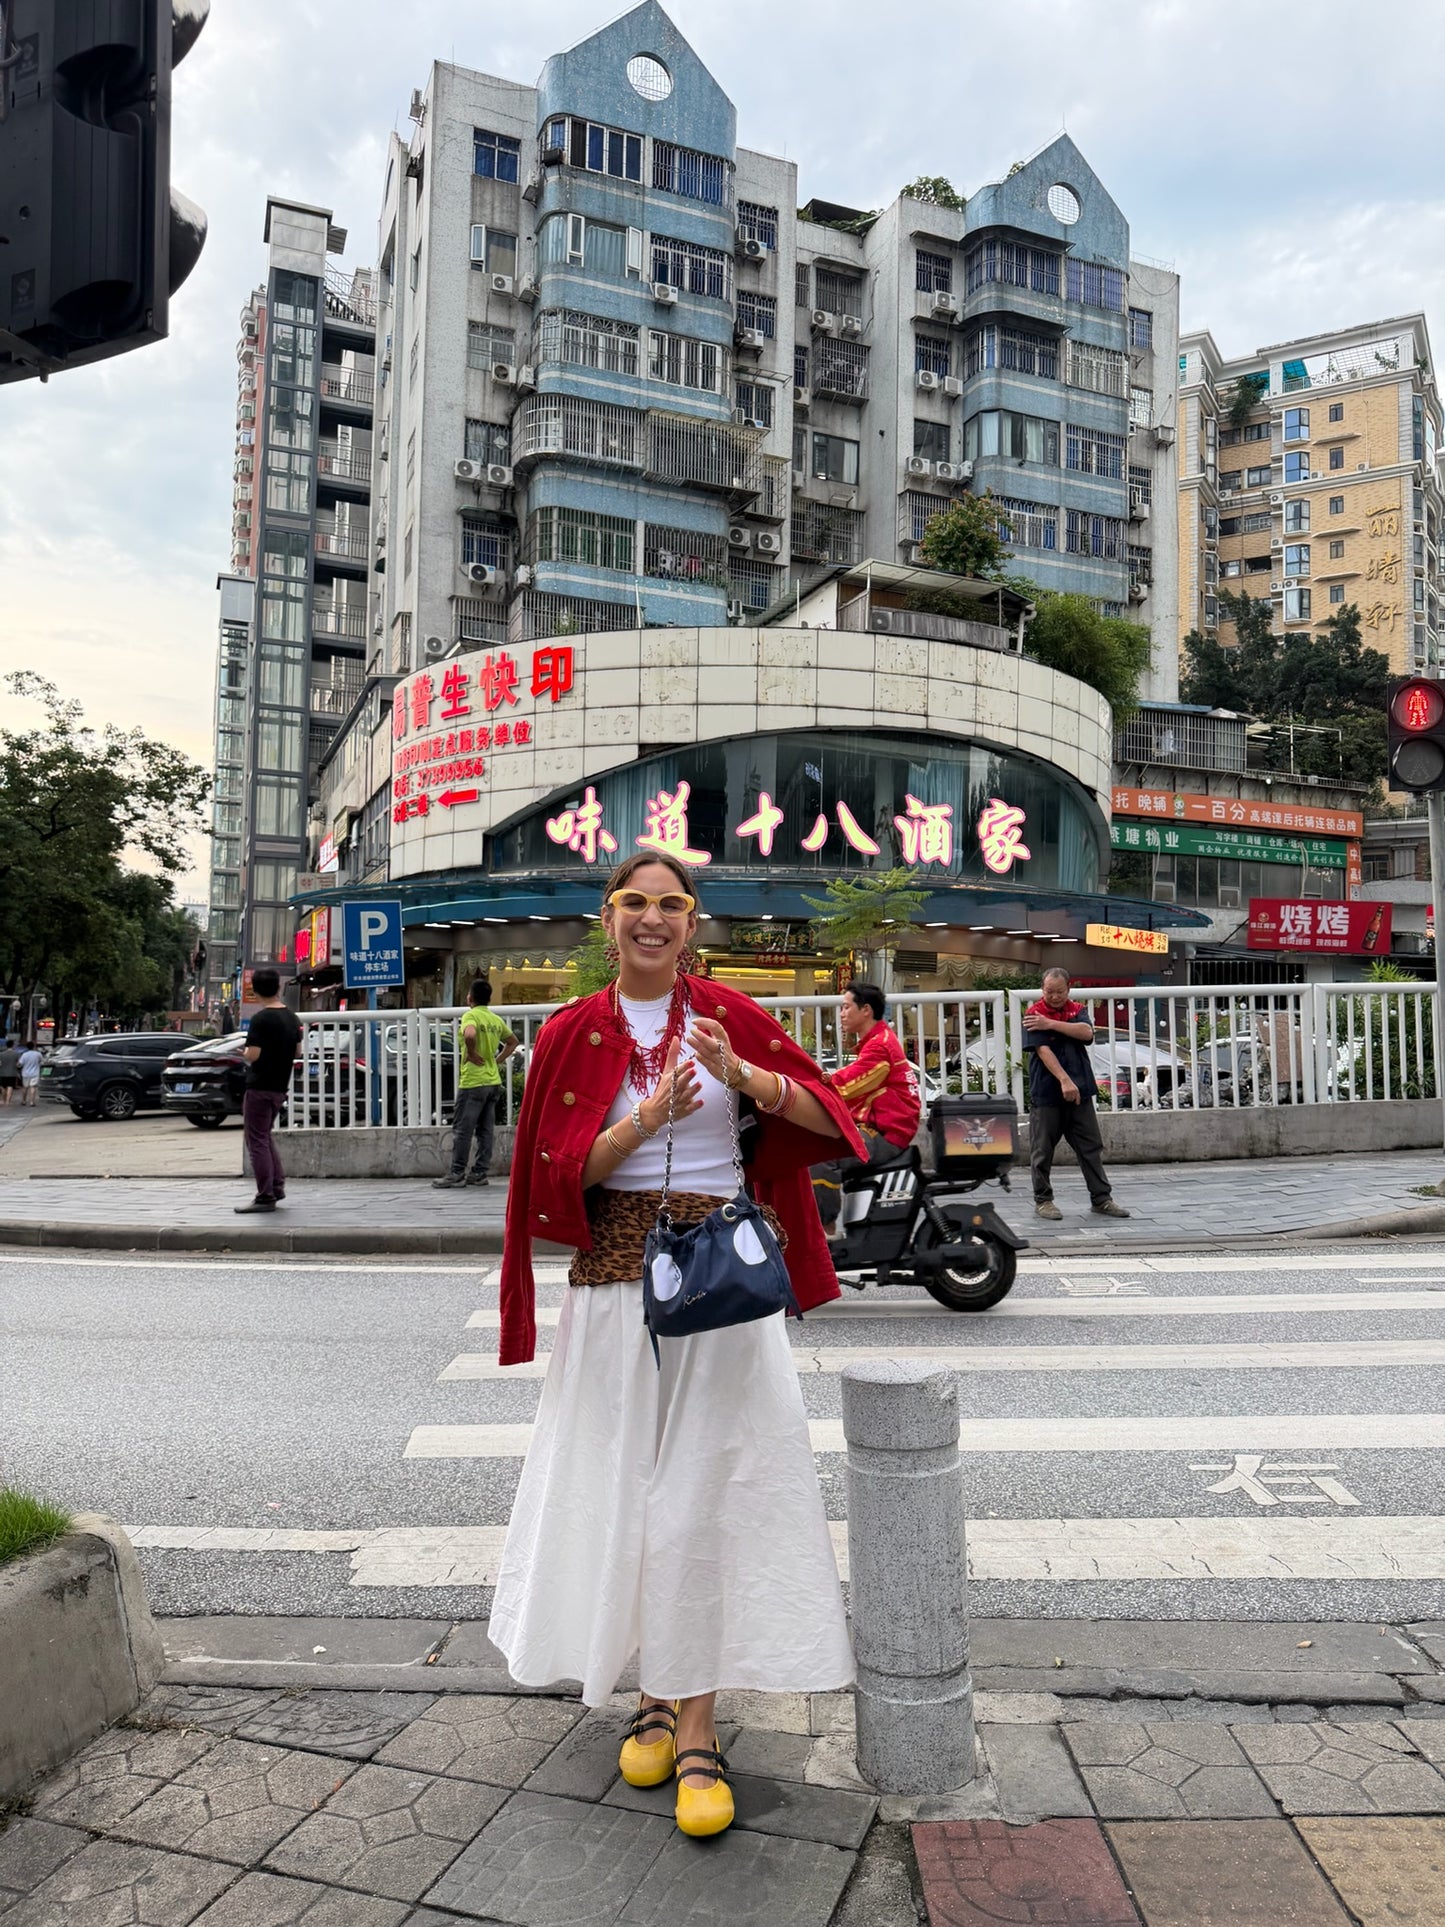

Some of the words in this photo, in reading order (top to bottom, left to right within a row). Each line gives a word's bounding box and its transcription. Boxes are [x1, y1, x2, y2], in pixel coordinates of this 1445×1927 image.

[1191, 800, 1246, 821] 一百分
[546, 780, 1031, 874] 味道十八酒家
[360, 911, 388, 950] P
[1280, 904, 1350, 935] 烧烤
[364, 962, 389, 973] 停车场
